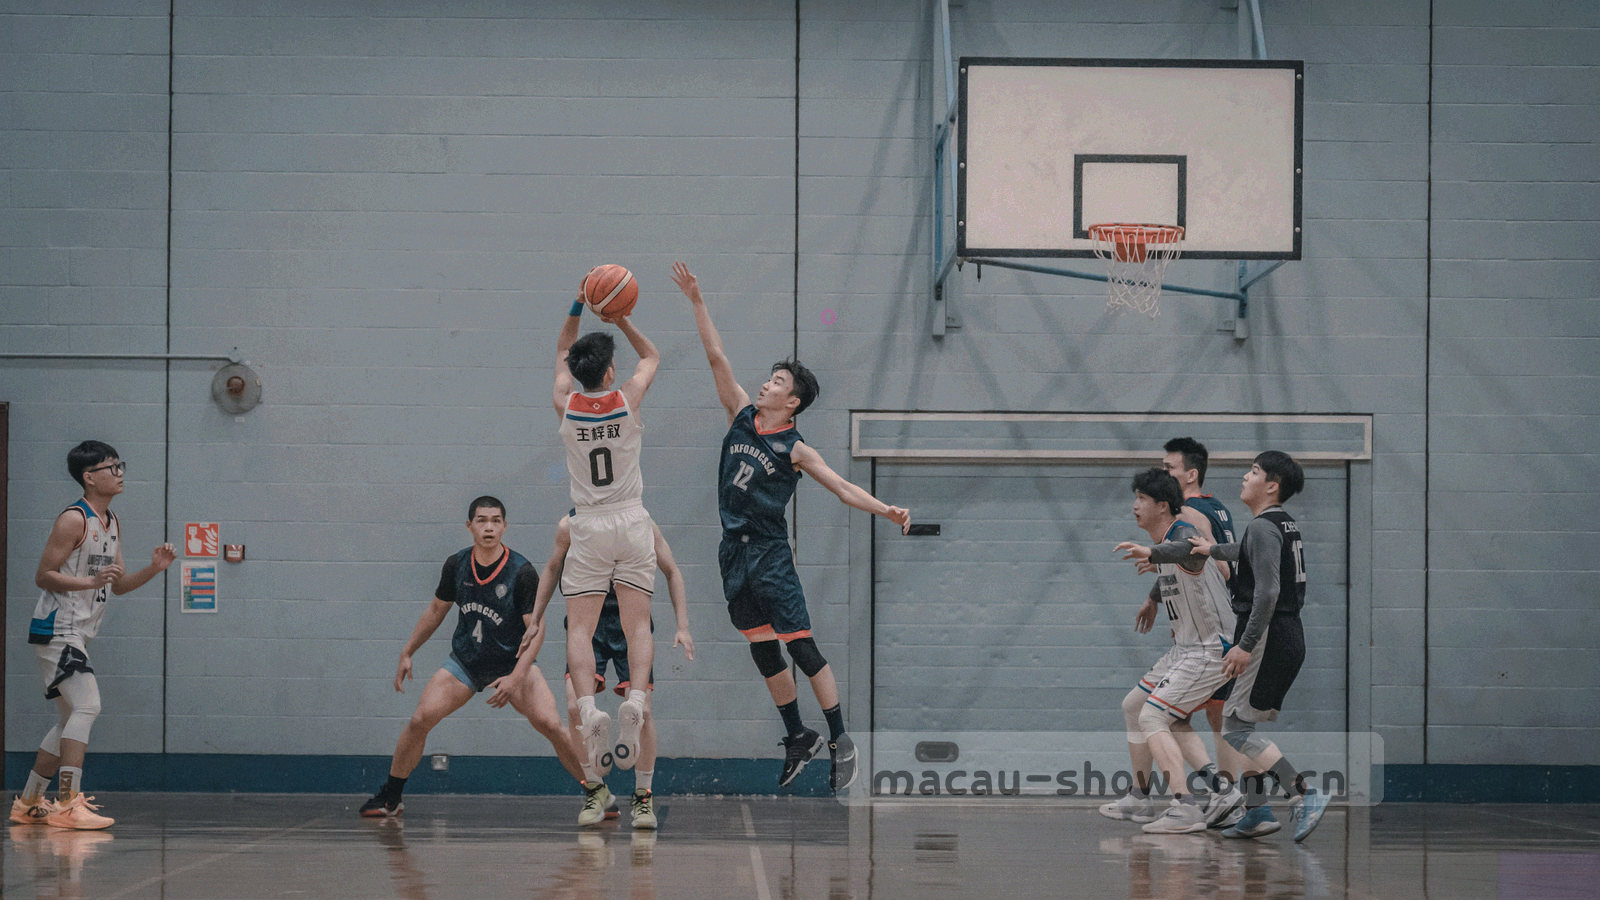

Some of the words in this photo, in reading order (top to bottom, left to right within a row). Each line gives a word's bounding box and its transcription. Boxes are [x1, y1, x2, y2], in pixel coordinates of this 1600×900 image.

[589, 447, 614, 487] 0
[733, 460, 755, 491] 12
[472, 619, 482, 643] 4
